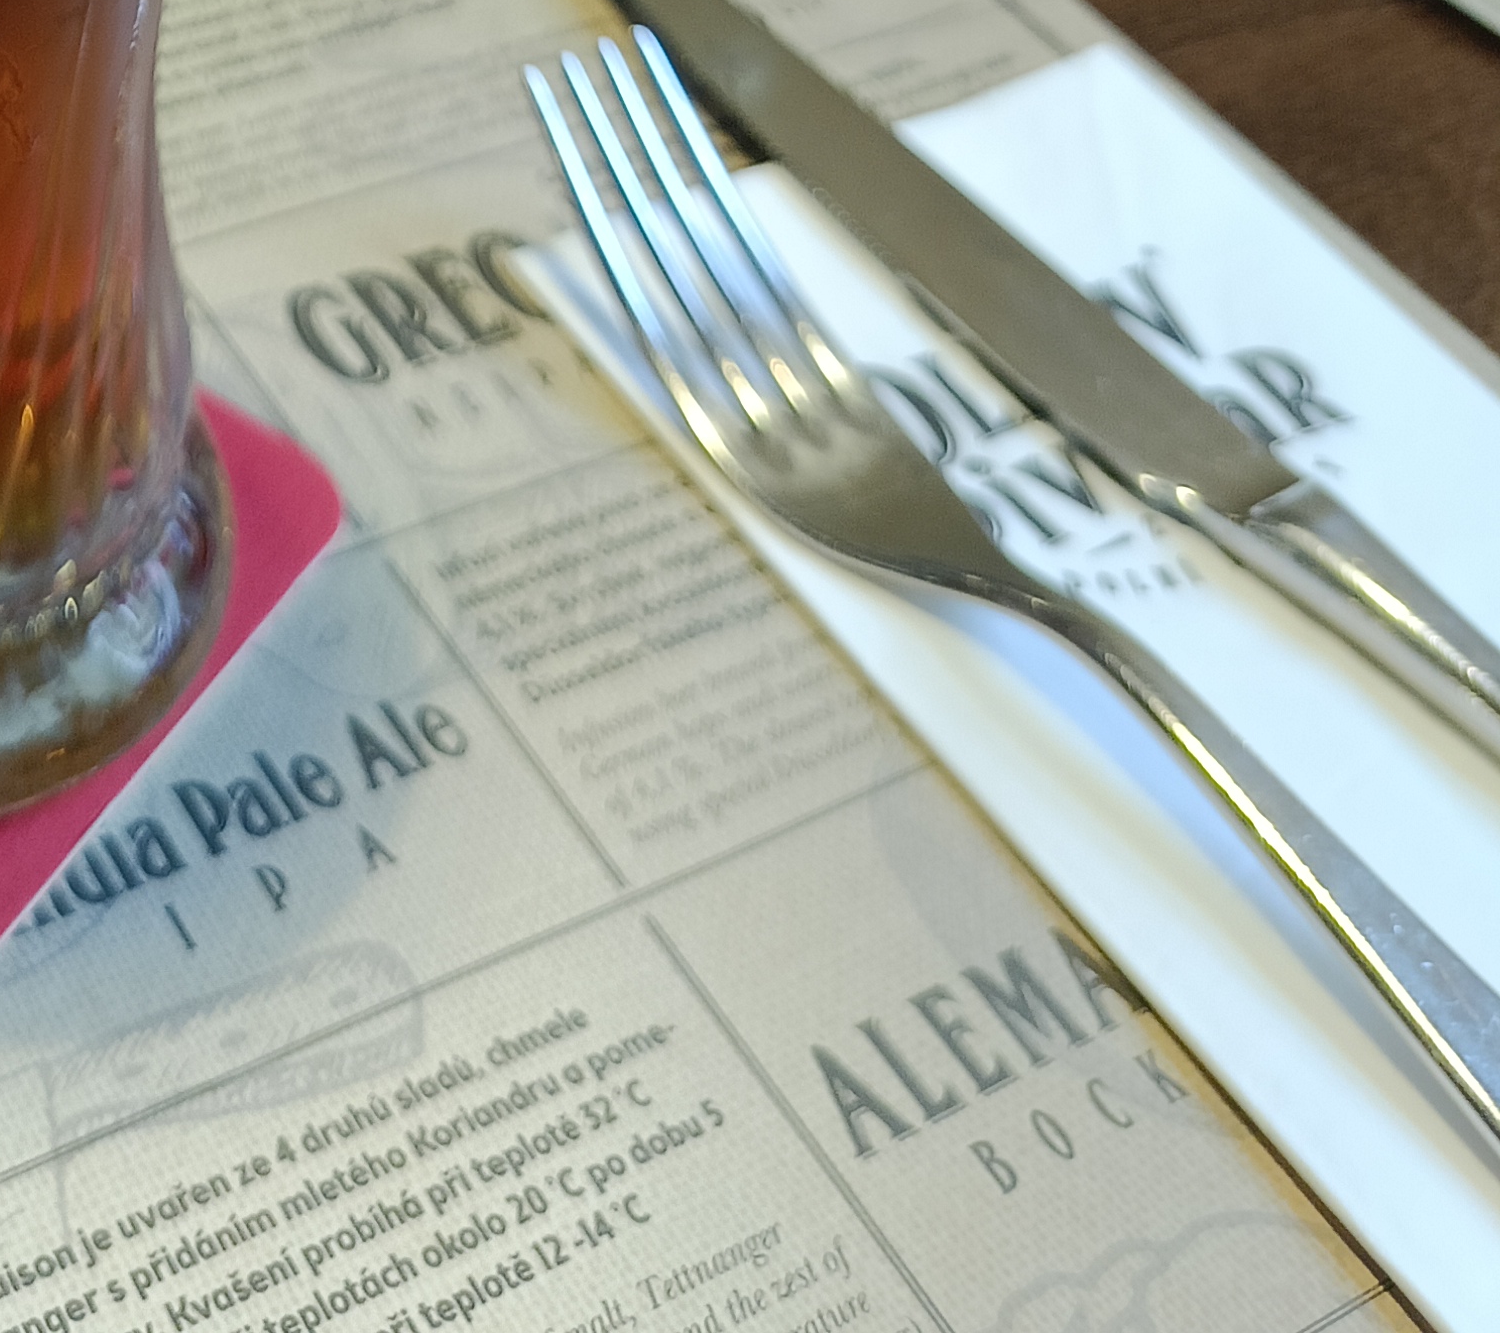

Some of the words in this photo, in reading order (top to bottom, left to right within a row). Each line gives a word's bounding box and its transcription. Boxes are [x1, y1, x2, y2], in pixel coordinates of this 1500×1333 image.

[173, 750, 343, 858] Pale
[347, 699, 469, 790] Ale
[77, 1227, 113, 1269] je
[116, 1173, 233, 1239] uvařen
[232, 1154, 273, 1188] ze
[275, 1134, 298, 1164] 4
[301, 1091, 395, 1157] druhů
[485, 1007, 592, 1070] chmele
[107, 1278, 127, 1304] s
[129, 1206, 277, 1301] přidáním
[278, 1146, 408, 1222] mletého
[405, 1068, 562, 1157] Koriandru
[563, 1063, 586, 1085] a
[968, 1049, 1190, 1195] BOCK
[164, 1245, 301, 1332] Kvašení
[301, 1188, 425, 1278] probíhá
[424, 1164, 473, 1216] při
[471, 1113, 582, 1185] teplotě
[578, 1094, 619, 1132] 32
[262, 1252, 419, 1333] teplotách
[421, 1212, 508, 1268] okolo
[505, 1182, 549, 1225] 20
[586, 1152, 628, 1195] po
[629, 1113, 704, 1166] dobu
[700, 1096, 726, 1130] 5
[418, 1251, 536, 1330] teplotě
[531, 1233, 571, 1271] 12
[635, 1222, 784, 1311] Tettnanger
[725, 1288, 769, 1325] the
[769, 1256, 819, 1302] zest
[822, 1233, 851, 1281] of
